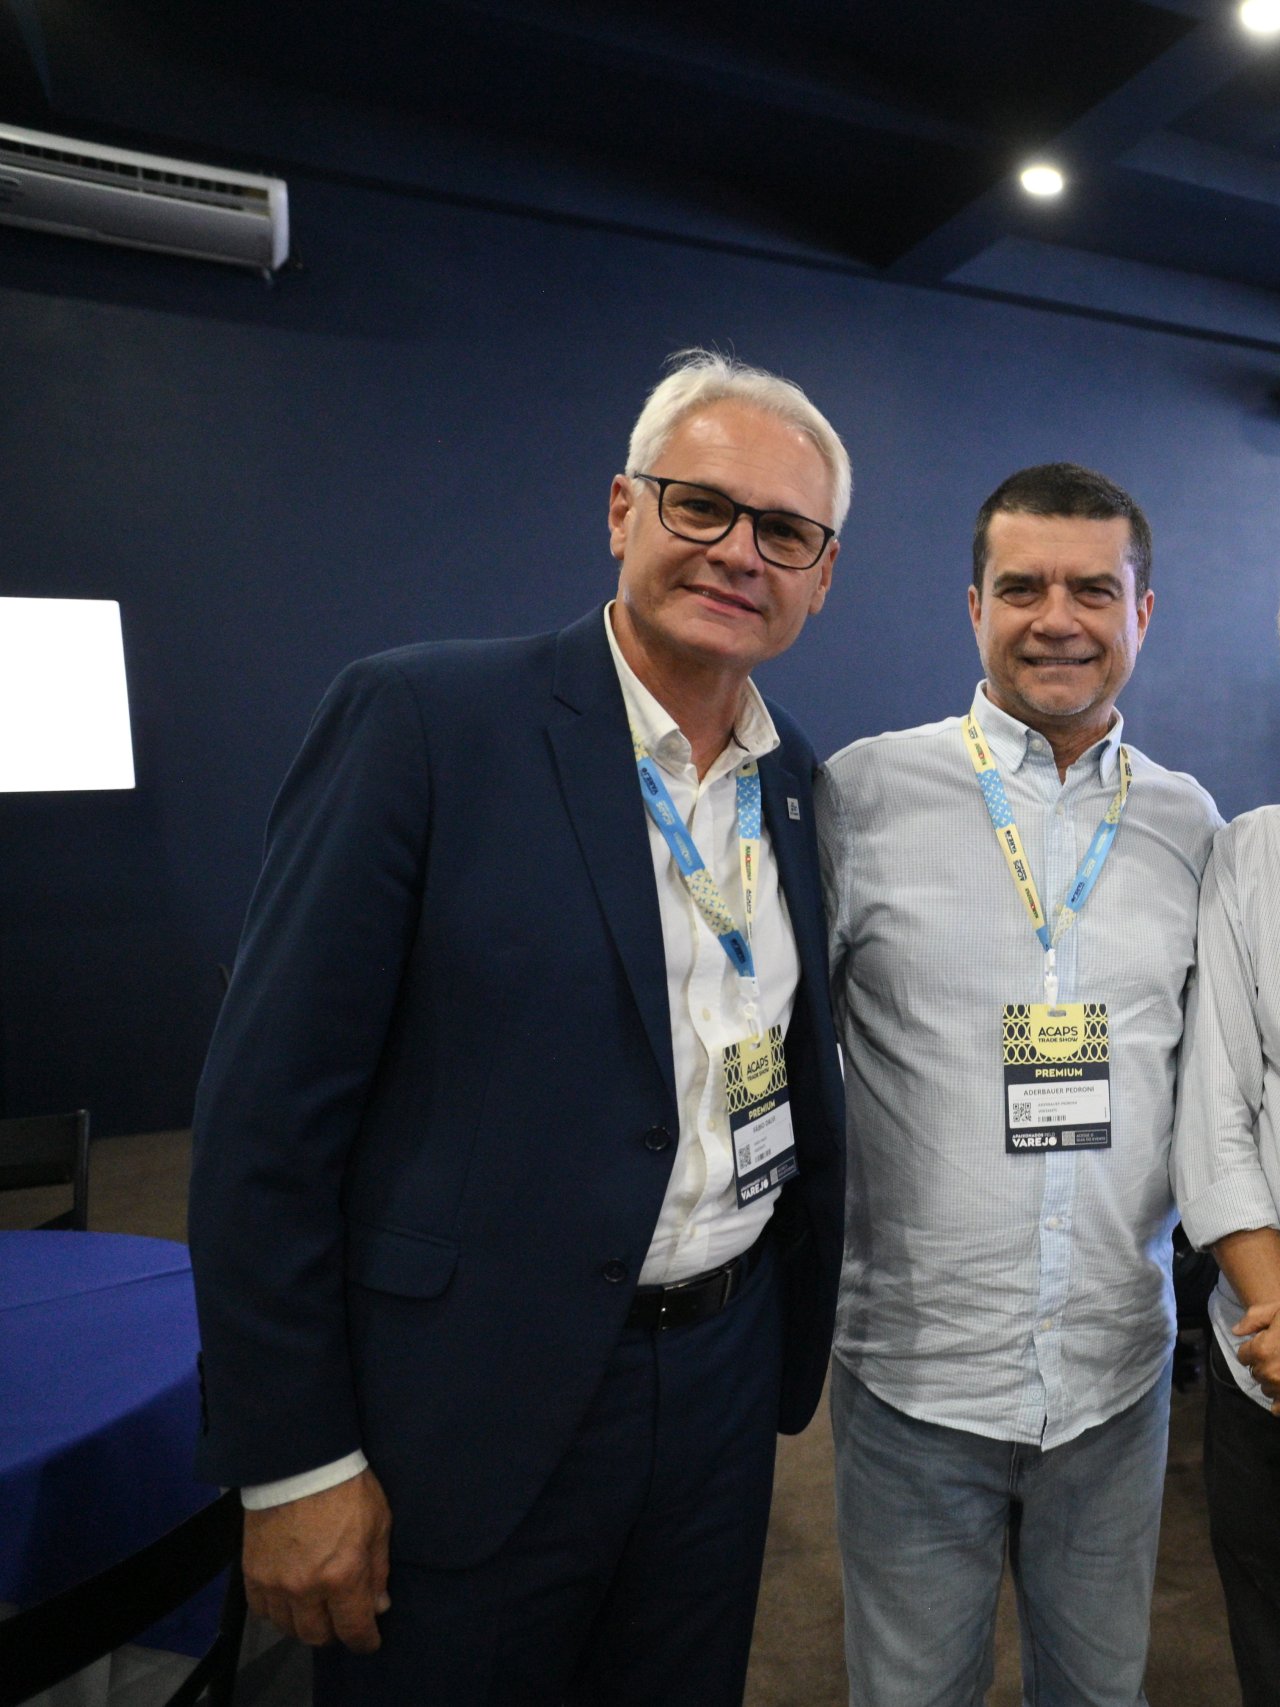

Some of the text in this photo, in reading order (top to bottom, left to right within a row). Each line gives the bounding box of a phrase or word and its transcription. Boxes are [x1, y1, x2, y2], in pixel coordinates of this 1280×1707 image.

[1005, 829, 1018, 853] VAREJO
[1012, 859, 1025, 882] ACAPS
[1038, 1026, 1078, 1037] ACAPS
[747, 1056, 769, 1074] ACAPS
[1035, 1068, 1083, 1078] PREMIUM
[1023, 1086, 1095, 1096] ADERBAUER PEDRONI
[749, 1099, 776, 1120] PREMIUM
[1012, 1136, 1058, 1148] VAREJO
[741, 1179, 769, 1200] VAREJO
